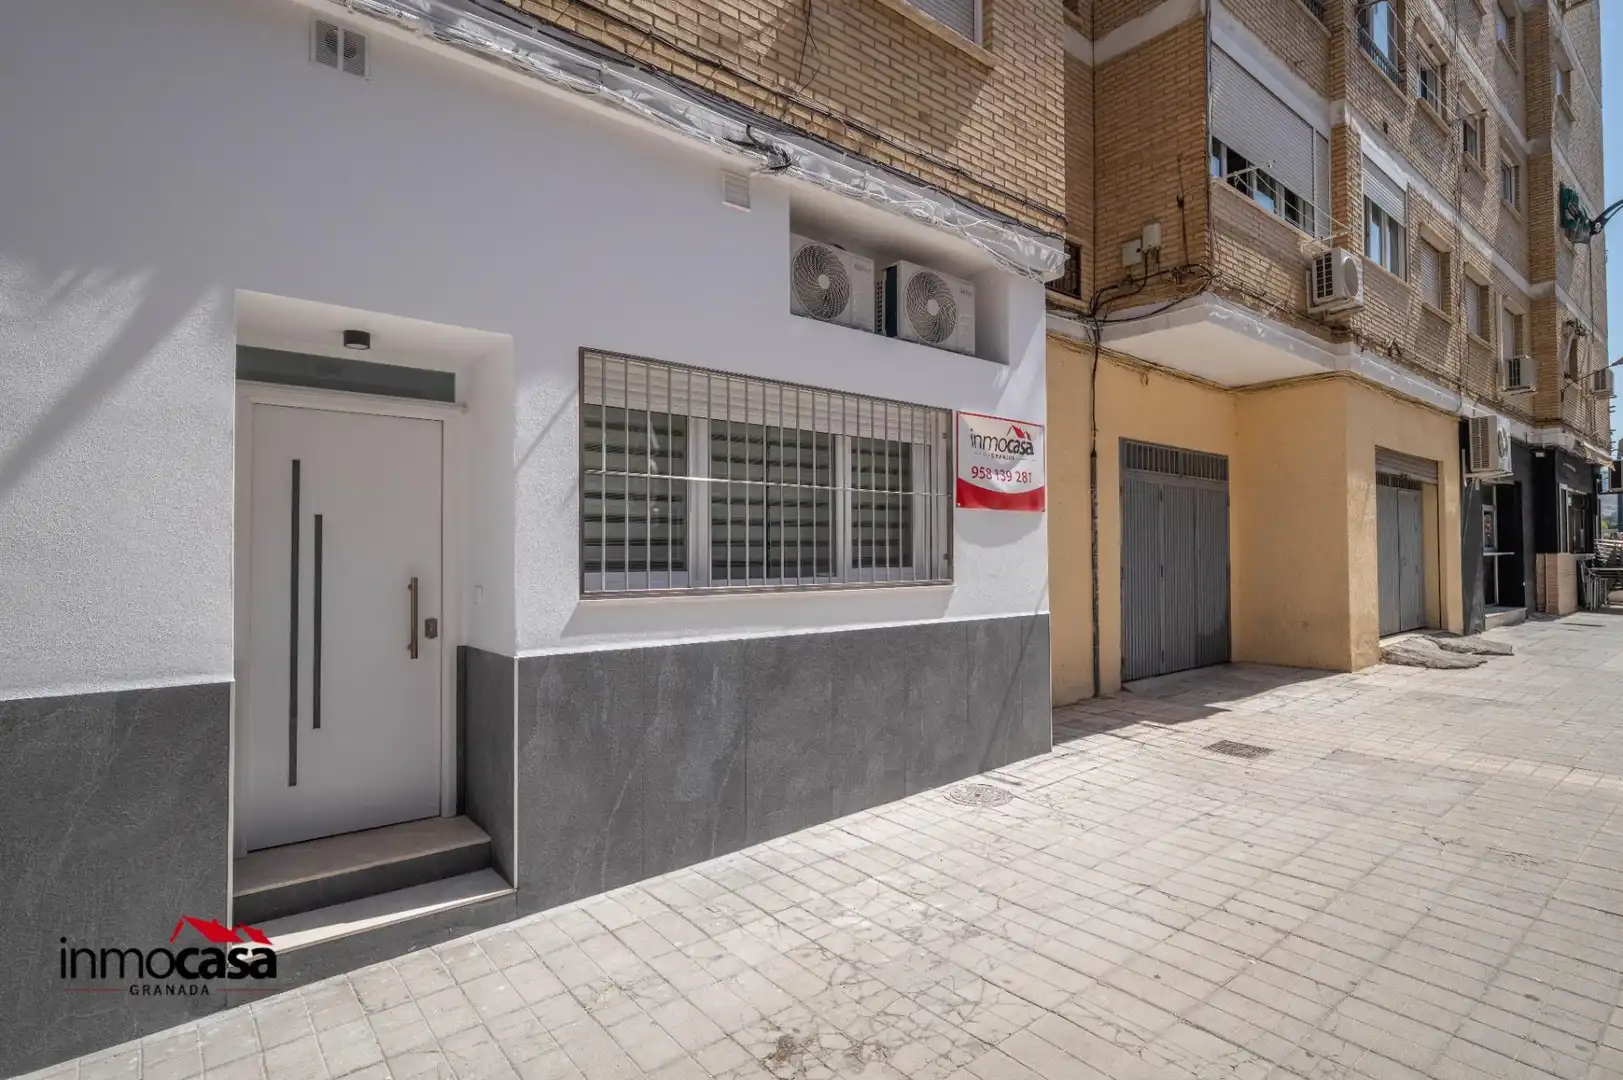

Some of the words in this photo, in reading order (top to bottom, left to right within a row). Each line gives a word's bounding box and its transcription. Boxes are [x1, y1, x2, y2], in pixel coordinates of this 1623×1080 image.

[970, 428, 1035, 455] inmocasa
[971, 466, 992, 480] 958
[994, 468, 1012, 482] 139
[1015, 470, 1032, 484] 281
